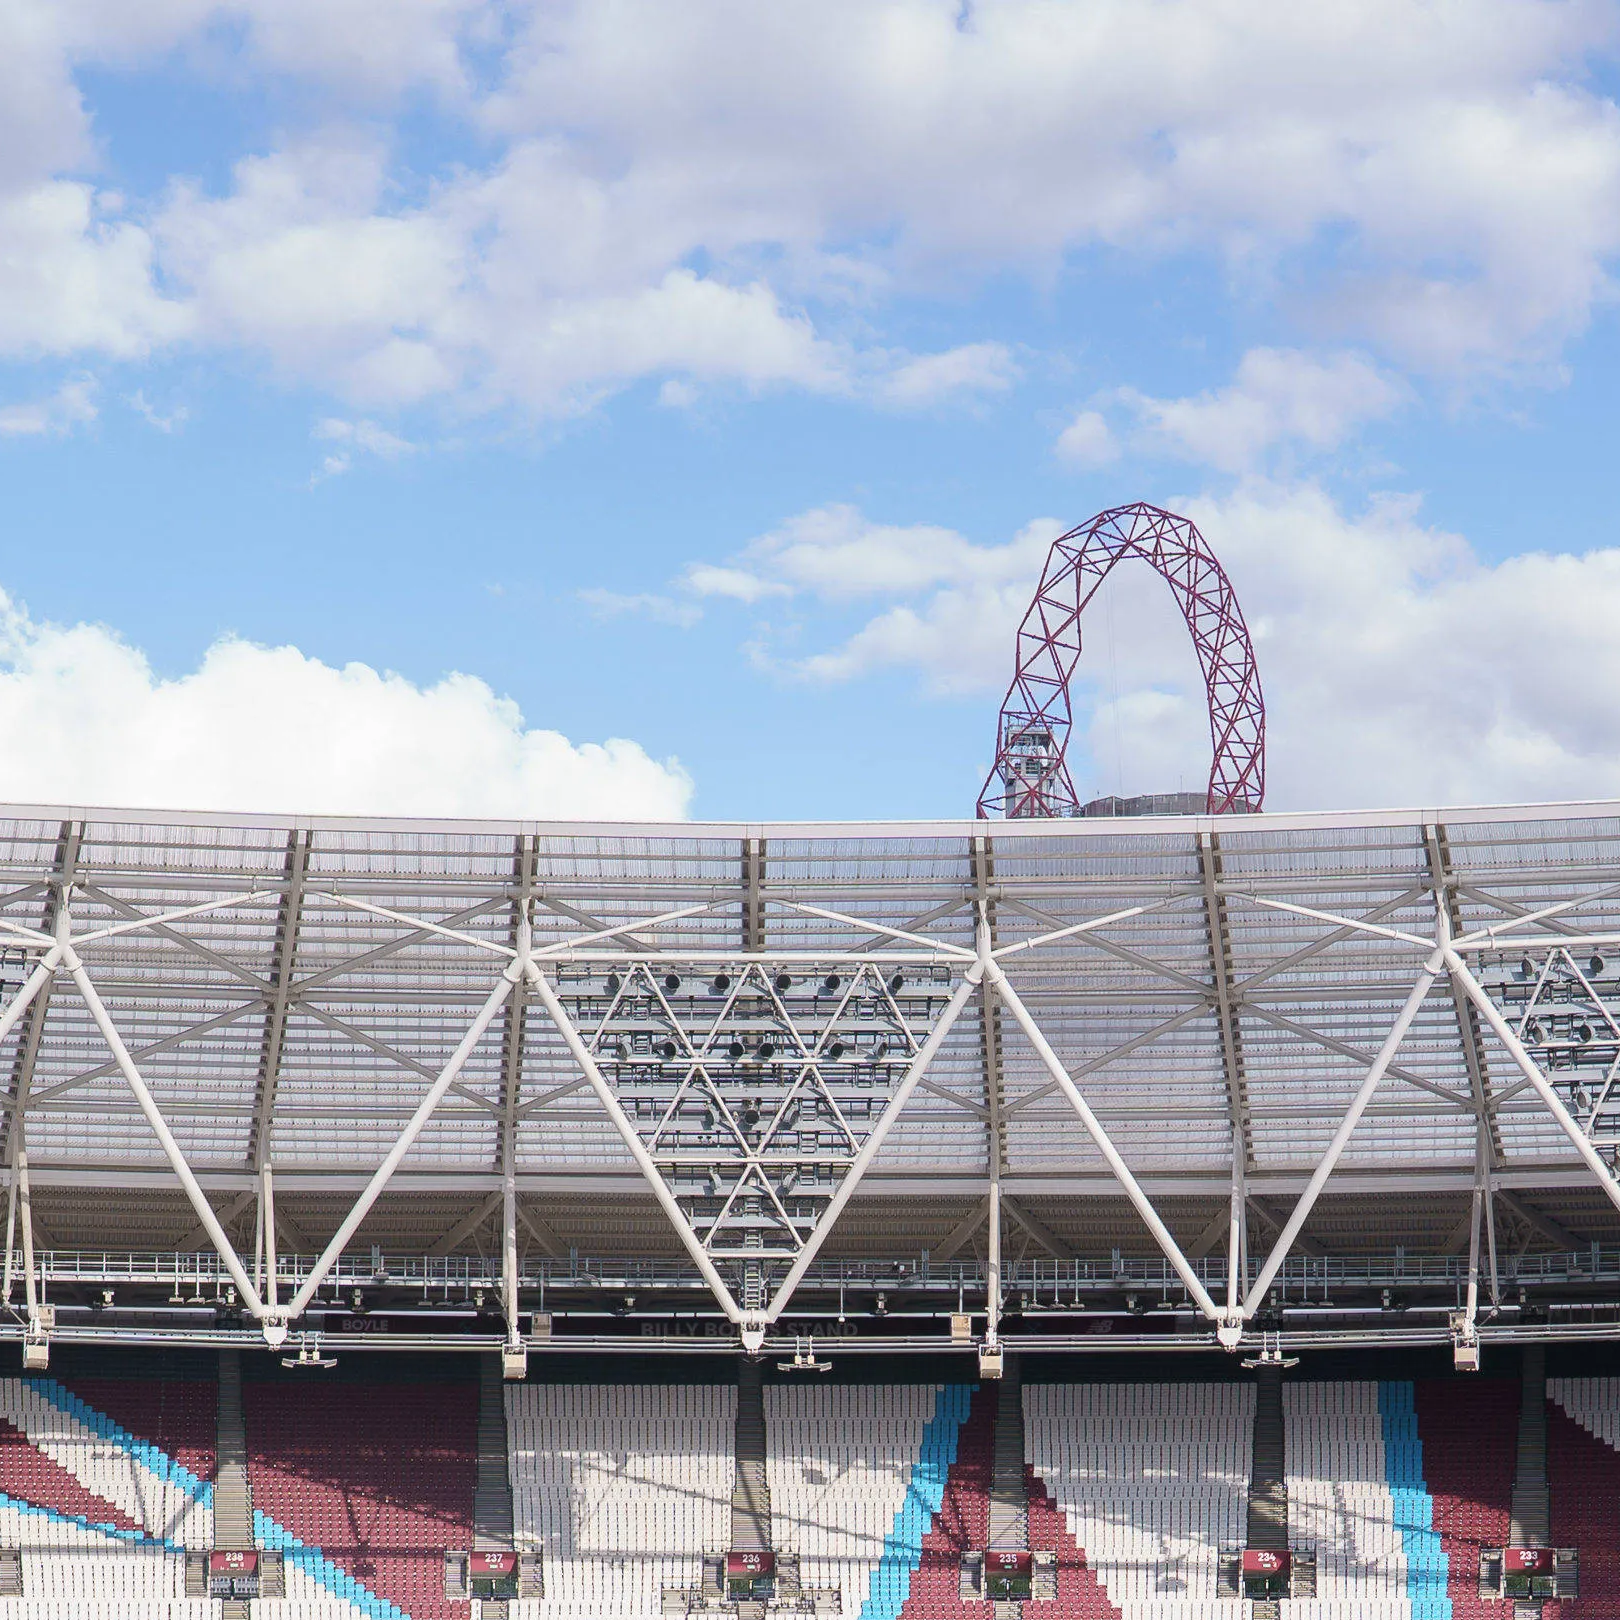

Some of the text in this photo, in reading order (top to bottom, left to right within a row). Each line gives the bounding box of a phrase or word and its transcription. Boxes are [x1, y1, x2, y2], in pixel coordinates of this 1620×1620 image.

[342, 1319, 389, 1332] BOYLE
[641, 1322, 857, 1337] BILLY BOS STAND
[225, 1552, 243, 1561] 238
[485, 1554, 503, 1562] 237
[742, 1554, 760, 1563] 236
[999, 1554, 1017, 1563] 235
[1258, 1553, 1276, 1562] 234
[1519, 1551, 1538, 1560] 233
